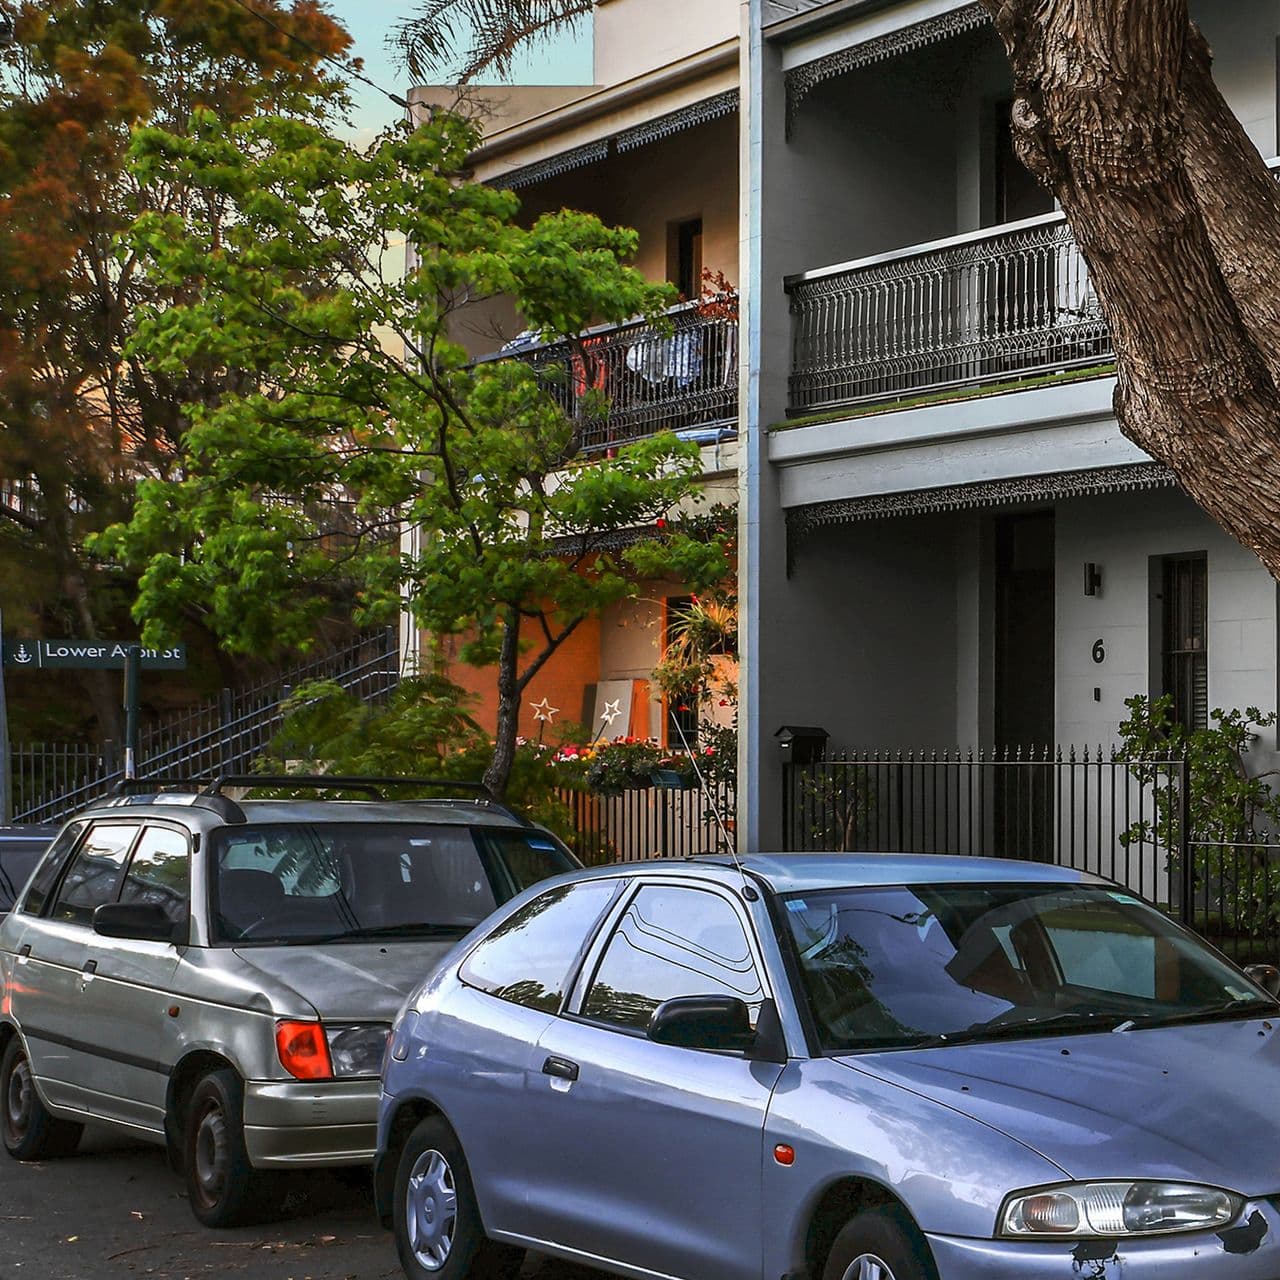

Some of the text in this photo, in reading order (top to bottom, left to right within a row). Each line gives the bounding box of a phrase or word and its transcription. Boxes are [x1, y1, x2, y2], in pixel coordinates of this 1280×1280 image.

[46, 643, 107, 658] Lower
[111, 644, 157, 658] Aon
[1092, 638, 1105, 664] 6
